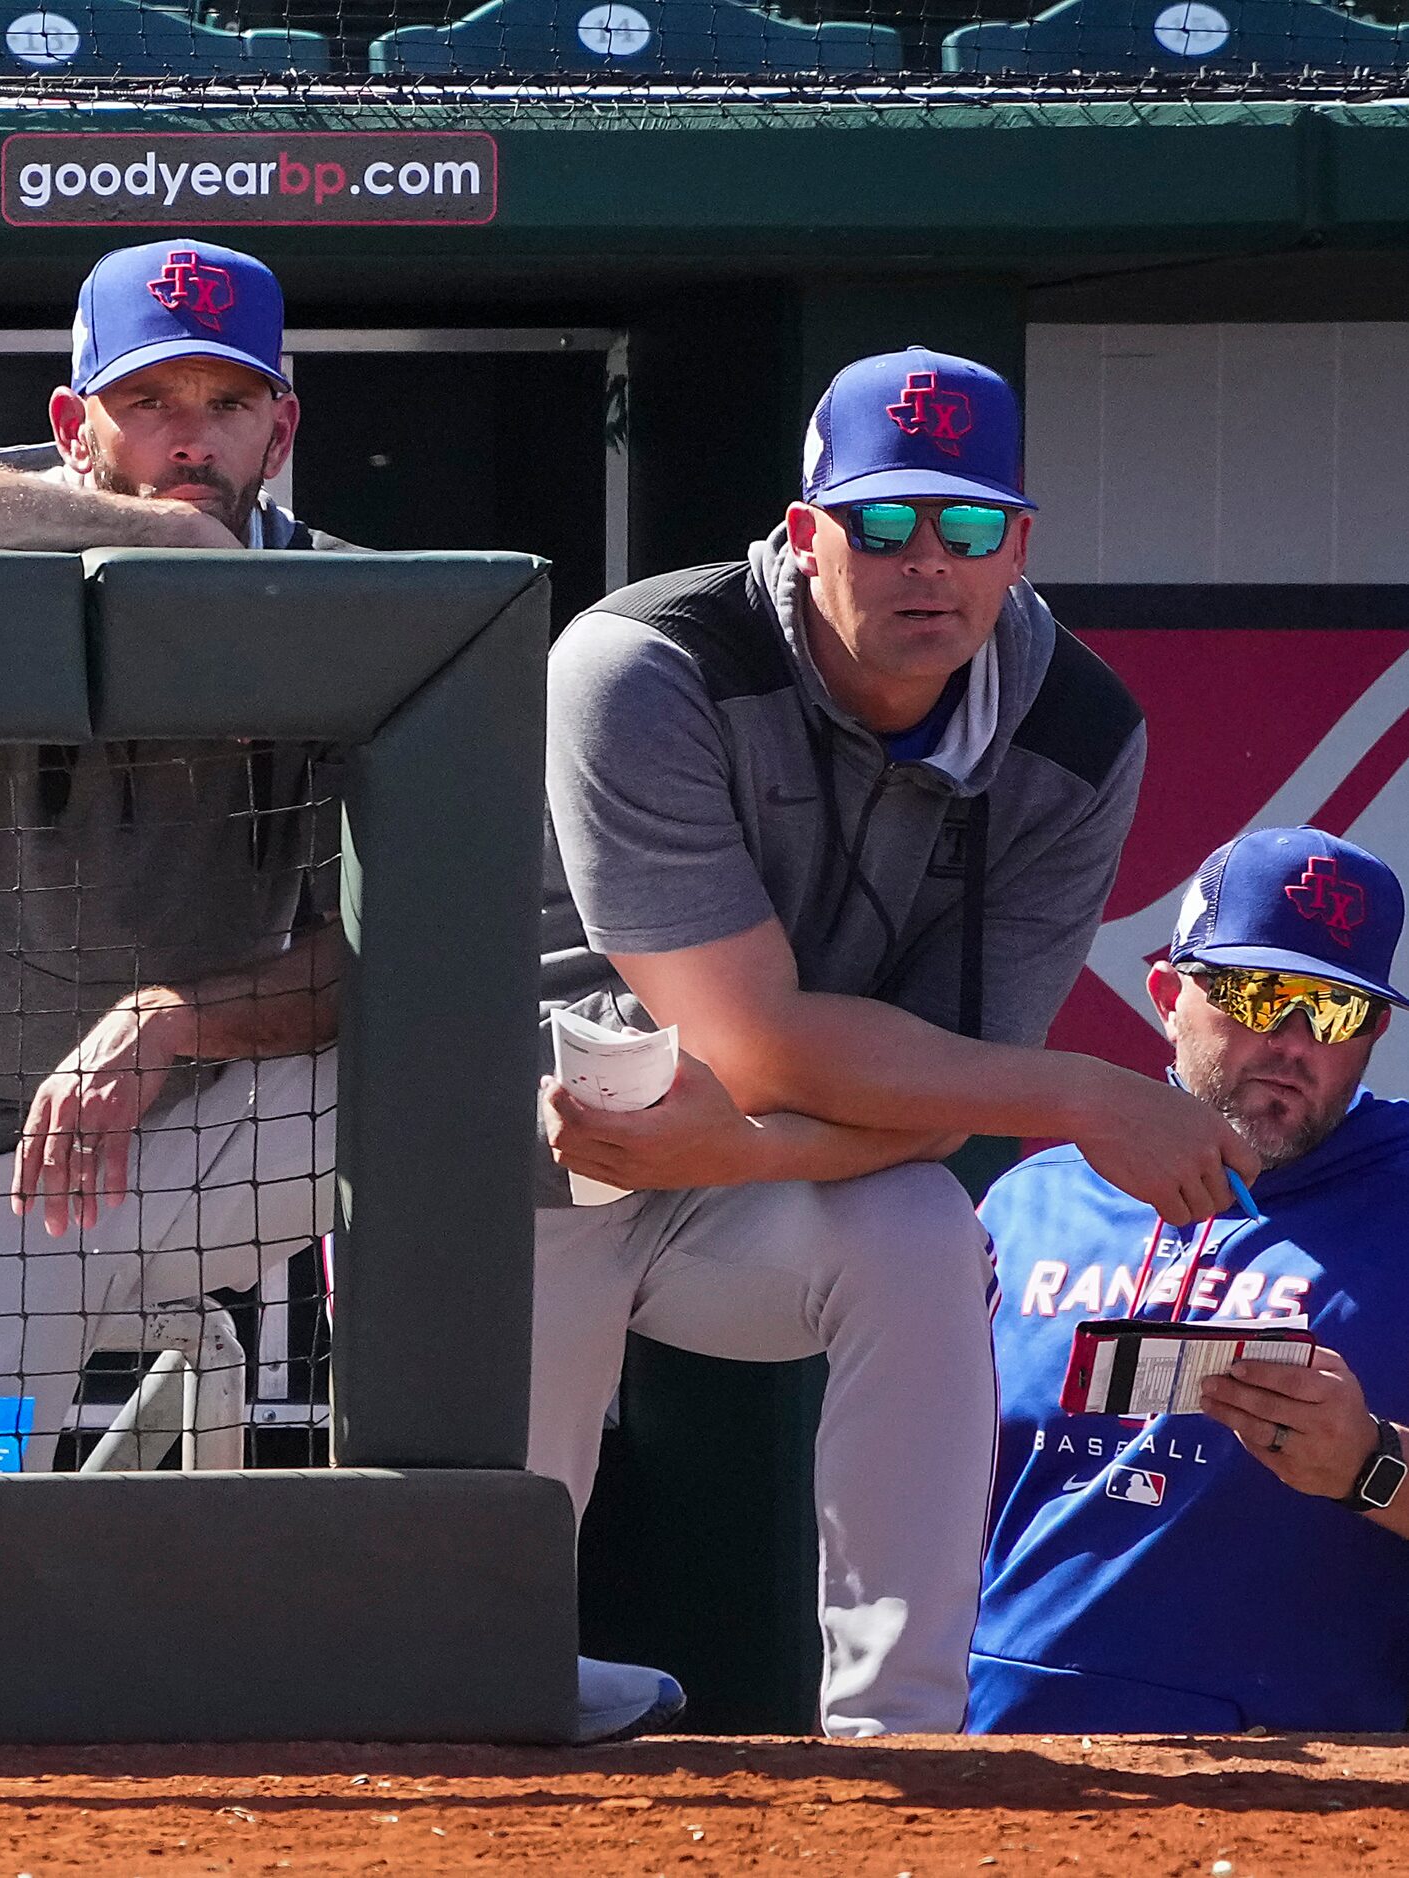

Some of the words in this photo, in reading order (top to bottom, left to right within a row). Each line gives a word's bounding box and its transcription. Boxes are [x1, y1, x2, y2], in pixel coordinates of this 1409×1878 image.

[19, 151, 481, 206] goodyearbp.com
[1021, 1259, 1312, 1321] RANGERS
[1034, 1429, 1208, 1464] BASEALL
